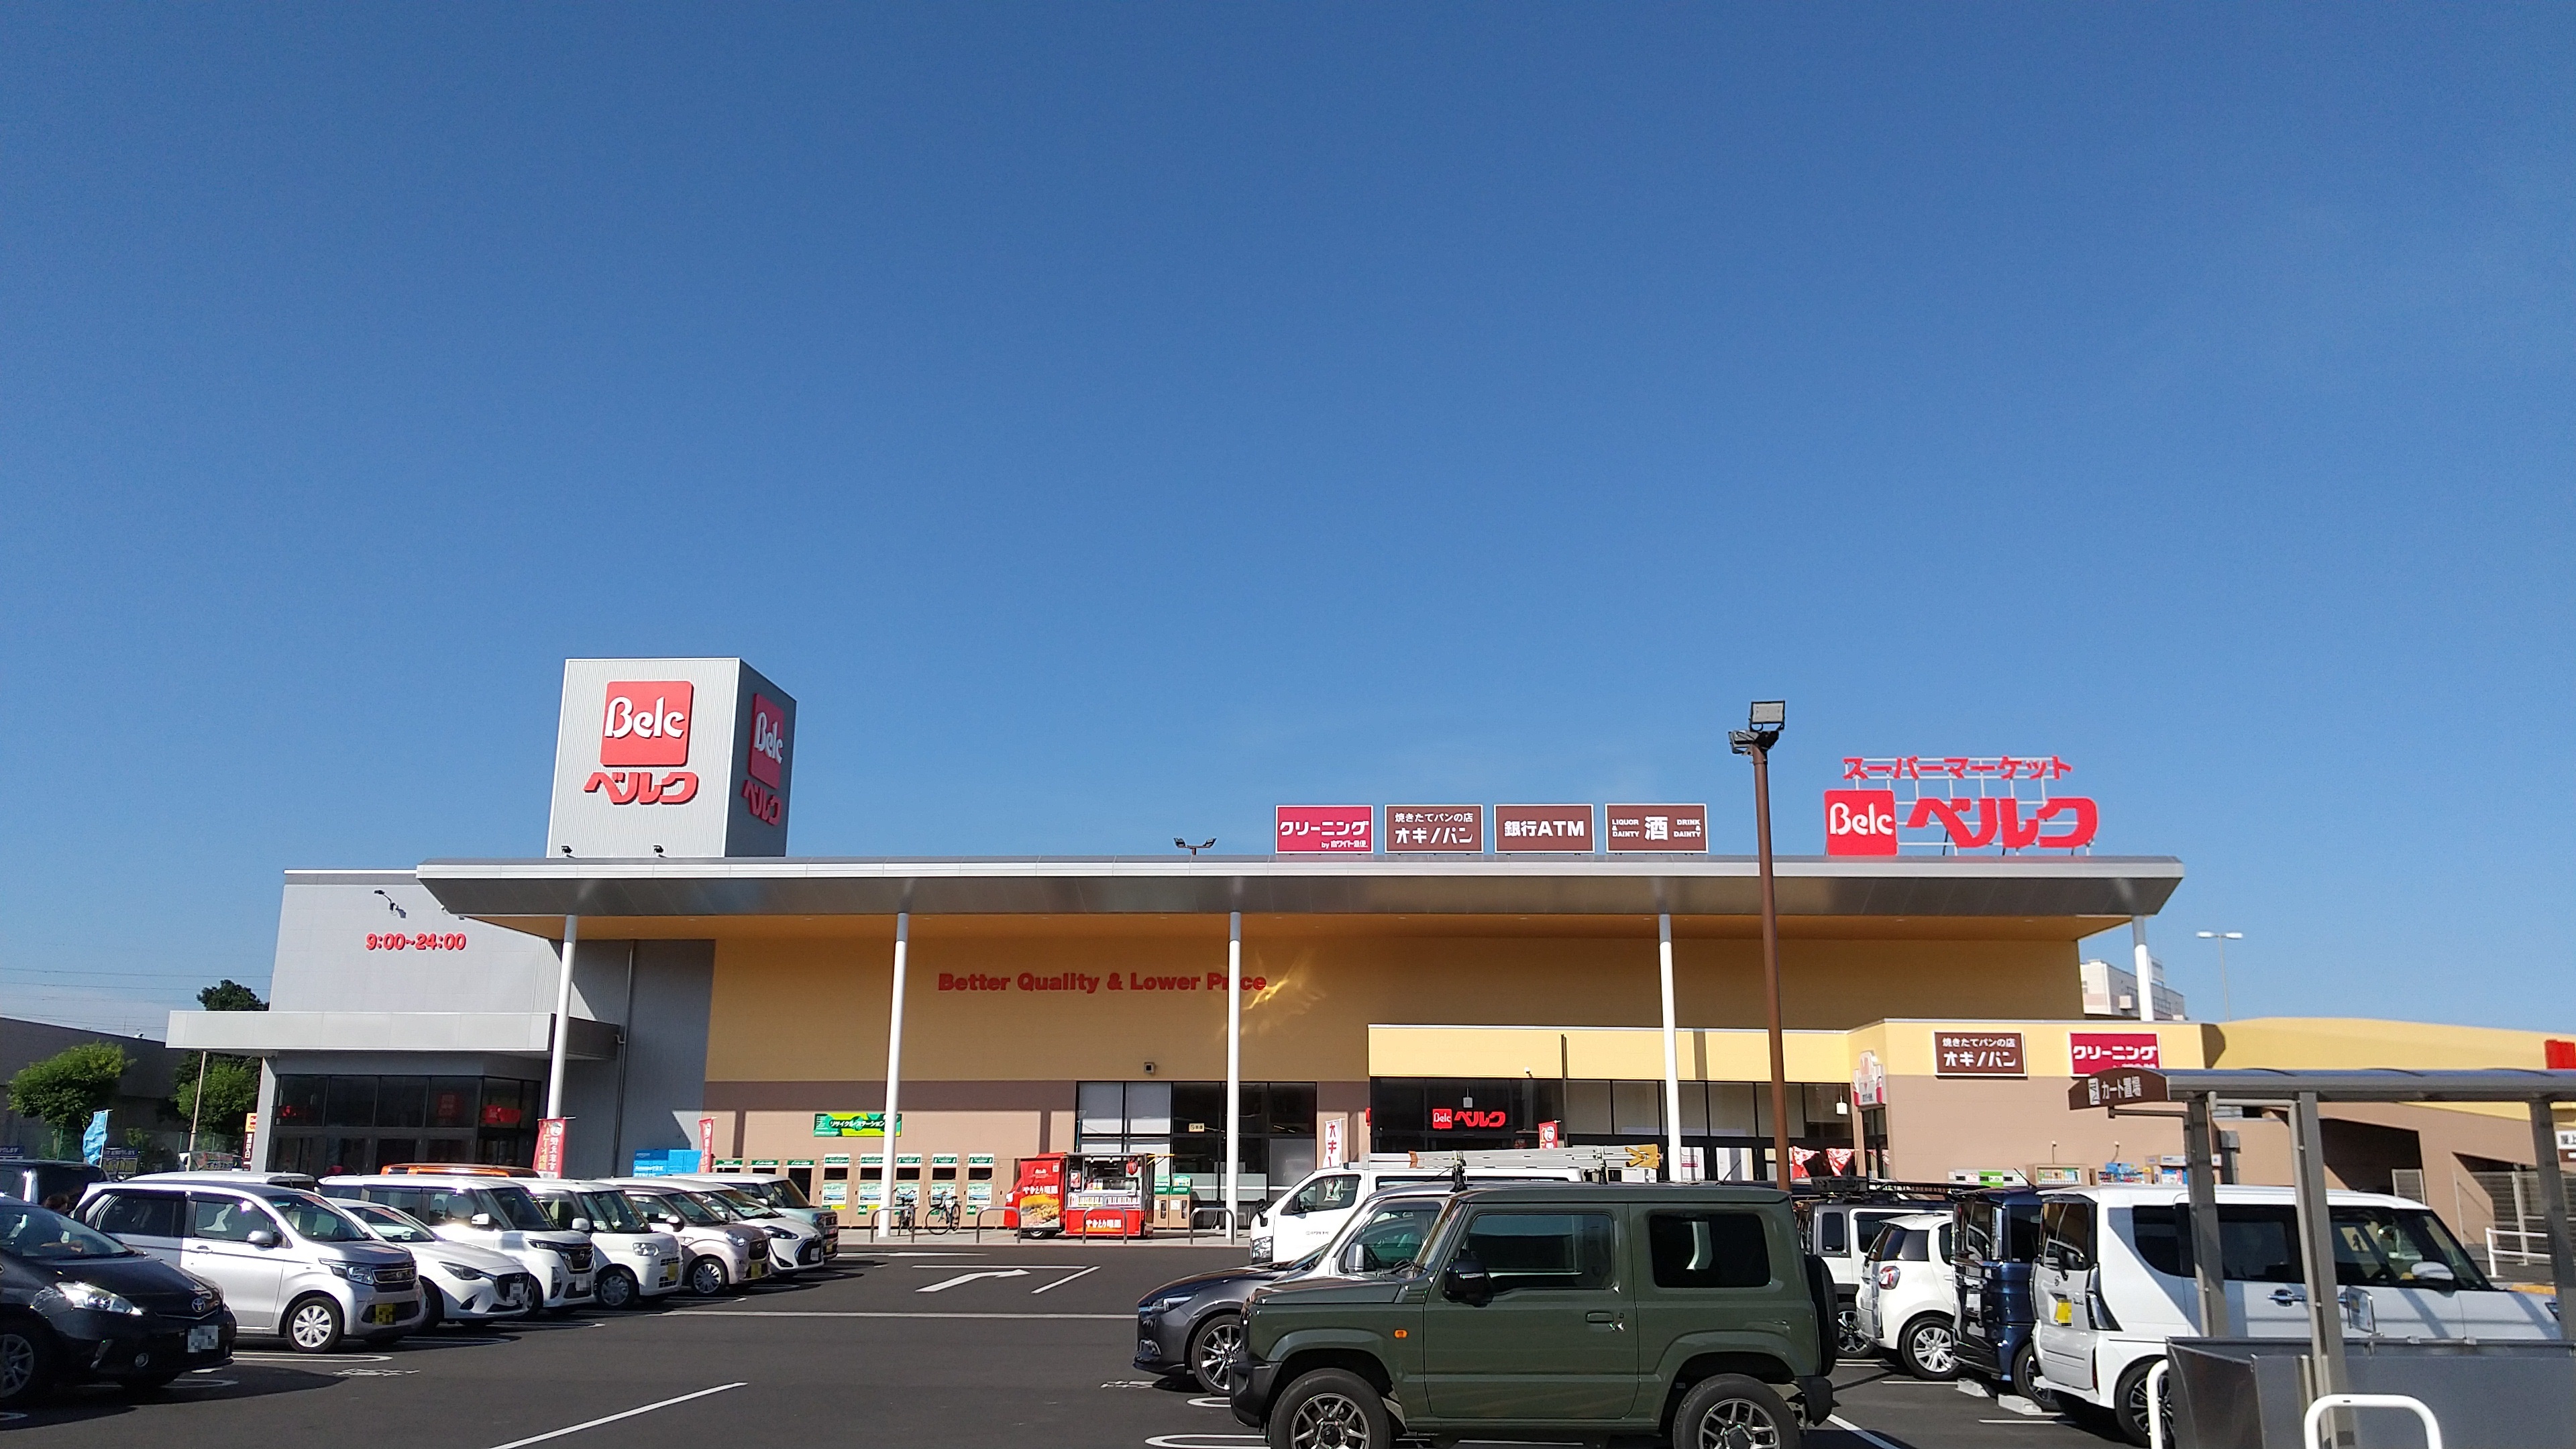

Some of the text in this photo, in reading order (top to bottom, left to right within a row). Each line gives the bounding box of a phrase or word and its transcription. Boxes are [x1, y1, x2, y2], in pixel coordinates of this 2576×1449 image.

[604, 696, 685, 739] Belc
[754, 712, 784, 764] Belc
[1843, 756, 2072, 780] スーパーマーケット
[583, 771, 698, 804] ベルク
[741, 780, 782, 826] ベルク
[1280, 820, 1369, 836] クリーニング
[1395, 812, 1474, 823] 焼きたてパンの店
[1504, 820, 1585, 837] 銀行ATM
[1644, 816, 1668, 841] 酒
[1829, 802, 1894, 835] Belc
[1906, 797, 2098, 849] ベルク
[1395, 826, 1473, 844] オギノパン
[938, 972, 1267, 994] Better Quality & Lower Prce
[1942, 1037, 2016, 1048] 焼きたてパンの店
[2073, 1045, 2157, 1060] クリーニング
[1943, 1051, 2016, 1067] オギノパン
[1433, 1111, 1506, 1128] Belc ベルク
